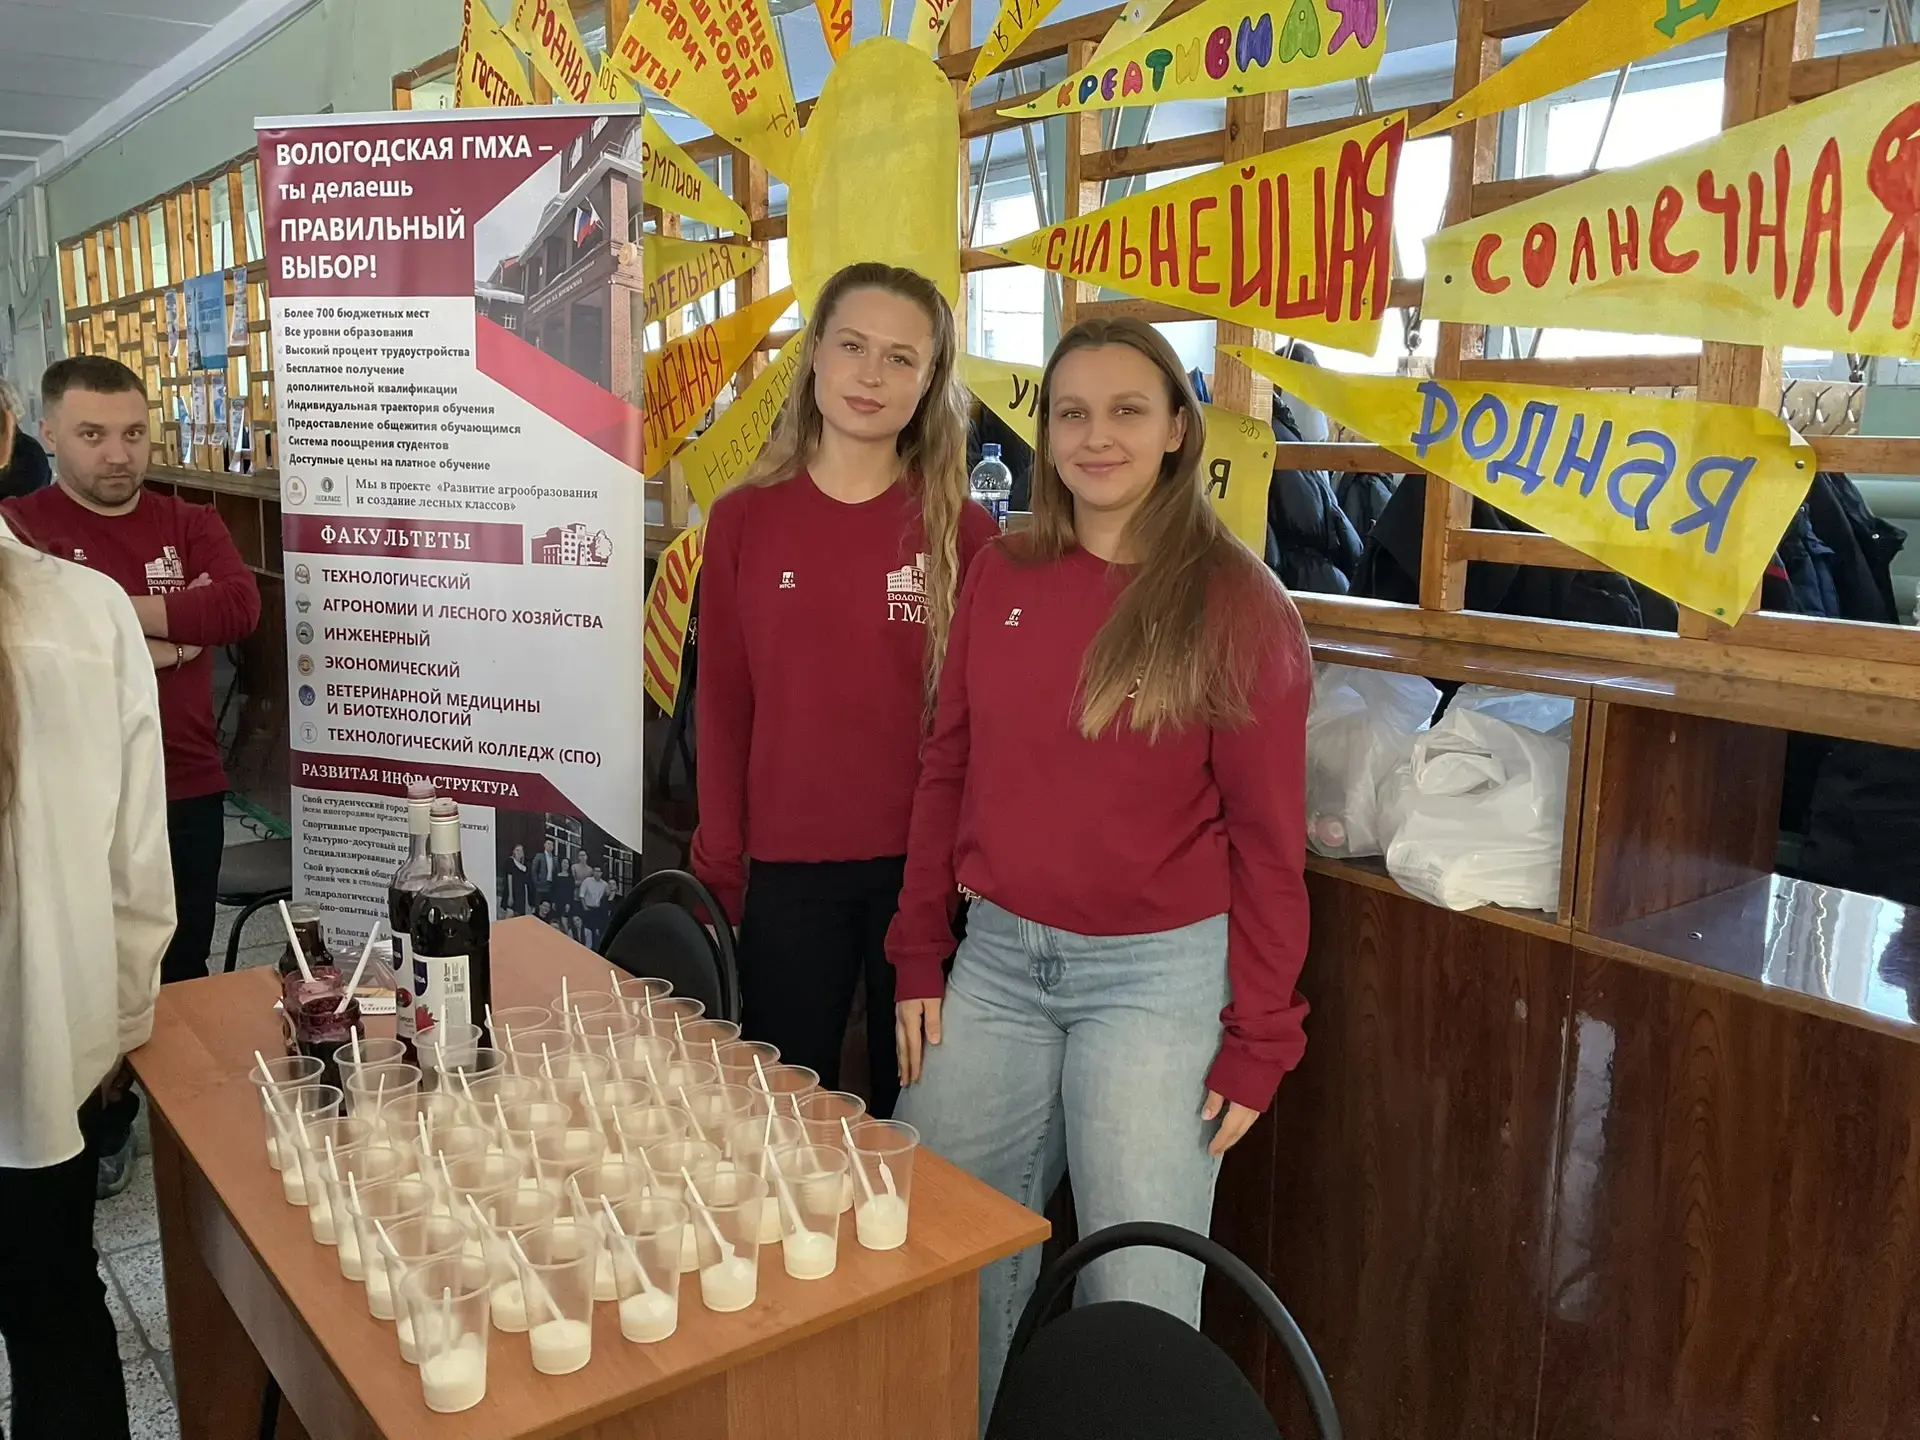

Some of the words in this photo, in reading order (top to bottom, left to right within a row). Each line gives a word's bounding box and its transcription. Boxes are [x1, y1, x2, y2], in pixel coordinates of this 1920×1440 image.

[1056, 0, 1379, 109] КРЕАТИВНАЯ
[621, 35, 681, 98] путь!
[276, 137, 455, 167] ВОЛОГОДСКАЯ
[462, 134, 532, 160] ГМХА
[278, 182, 306, 200] ты
[311, 178, 414, 204] делаешь
[280, 208, 466, 243] ПРАВИЛЬНЫЙ
[1046, 118, 1405, 322] СИЛЬНЕЙШАЯ
[281, 255, 378, 280] ВЫБОР!
[284, 308, 314, 319] Более
[316, 308, 335, 318] 700
[337, 309, 404, 321] бюджетных
[405, 310, 430, 319] мест
[285, 327, 301, 337] Все
[303, 329, 341, 340] уровни
[343, 327, 414, 338] образования
[285, 345, 330, 356] Высокий
[332, 348, 378, 358] процент
[381, 348, 470, 359] трудоустройства
[286, 364, 343, 374] Бесплатное
[345, 366, 405, 377] получение
[287, 383, 375, 395] дополнительной
[377, 383, 458, 396] квалификации
[287, 400, 377, 414] Индивидуальная
[380, 403, 440, 415] траектория
[442, 404, 495, 416] обучения
[288, 418, 374, 431] Предоставление
[377, 421, 438, 433] общежития
[440, 423, 521, 435] обучающимся
[288, 436, 329, 447] Система
[331, 438, 395, 451] поощрения
[396, 440, 450, 452] студентов
[289, 454, 345, 467] Доступные
[347, 457, 378, 468] цены
[380, 459, 394, 467] на
[395, 459, 437, 469] платное
[439, 459, 491, 472] обучение
[356, 478, 378, 491] Мы
[380, 482, 387, 491] в
[388, 481, 431, 495] проекте
[437, 482, 495, 496] «Развитие
[498, 485, 599, 500] агрообразования
[356, 496, 364, 505] и
[366, 496, 417, 507] создание
[418, 498, 464, 509] лесных
[465, 500, 516, 511] классов»
[320, 524, 471, 550] ФАКУЛЬТЕТЫ
[322, 569, 471, 590] ТЕХНОЛОГИЧЕСКИЙ
[323, 598, 418, 618] АГРОНОМИИ
[422, 604, 433, 618] И
[438, 605, 507, 623] ЛЕСНОГО
[511, 608, 603, 629] ХОЗЯЙСТВА
[324, 626, 431, 647] ИНЖЕНЕРНЫЙ
[324, 655, 460, 678] ЭКОНОМИЧЕСКИЙ
[326, 684, 442, 706] ВЕТЕРИНАРНОЙ
[446, 694, 541, 714] МЕДИЦИНЫ
[327, 702, 338, 715] И
[342, 703, 472, 726] БИОТЕХНОЛОГИЙ
[328, 727, 474, 753] ТЕХНОЛОГИЧЕСКИЙ
[477, 741, 555, 762] КОЛЛЕДЖ
[558, 746, 602, 767] (СПО)
[302, 763, 379, 781] РАЗВИТАЯ
[302, 794, 323, 804] Свой
[323, 797, 385, 810] студенческий
[302, 819, 358, 832] Спортивные
[303, 833, 396, 851] Культурно-досуговый
[303, 847, 397, 865] Специализированные
[303, 862, 324, 873] Свой
[325, 865, 370, 878] вузовский
[304, 887, 385, 905] Дендрологический
